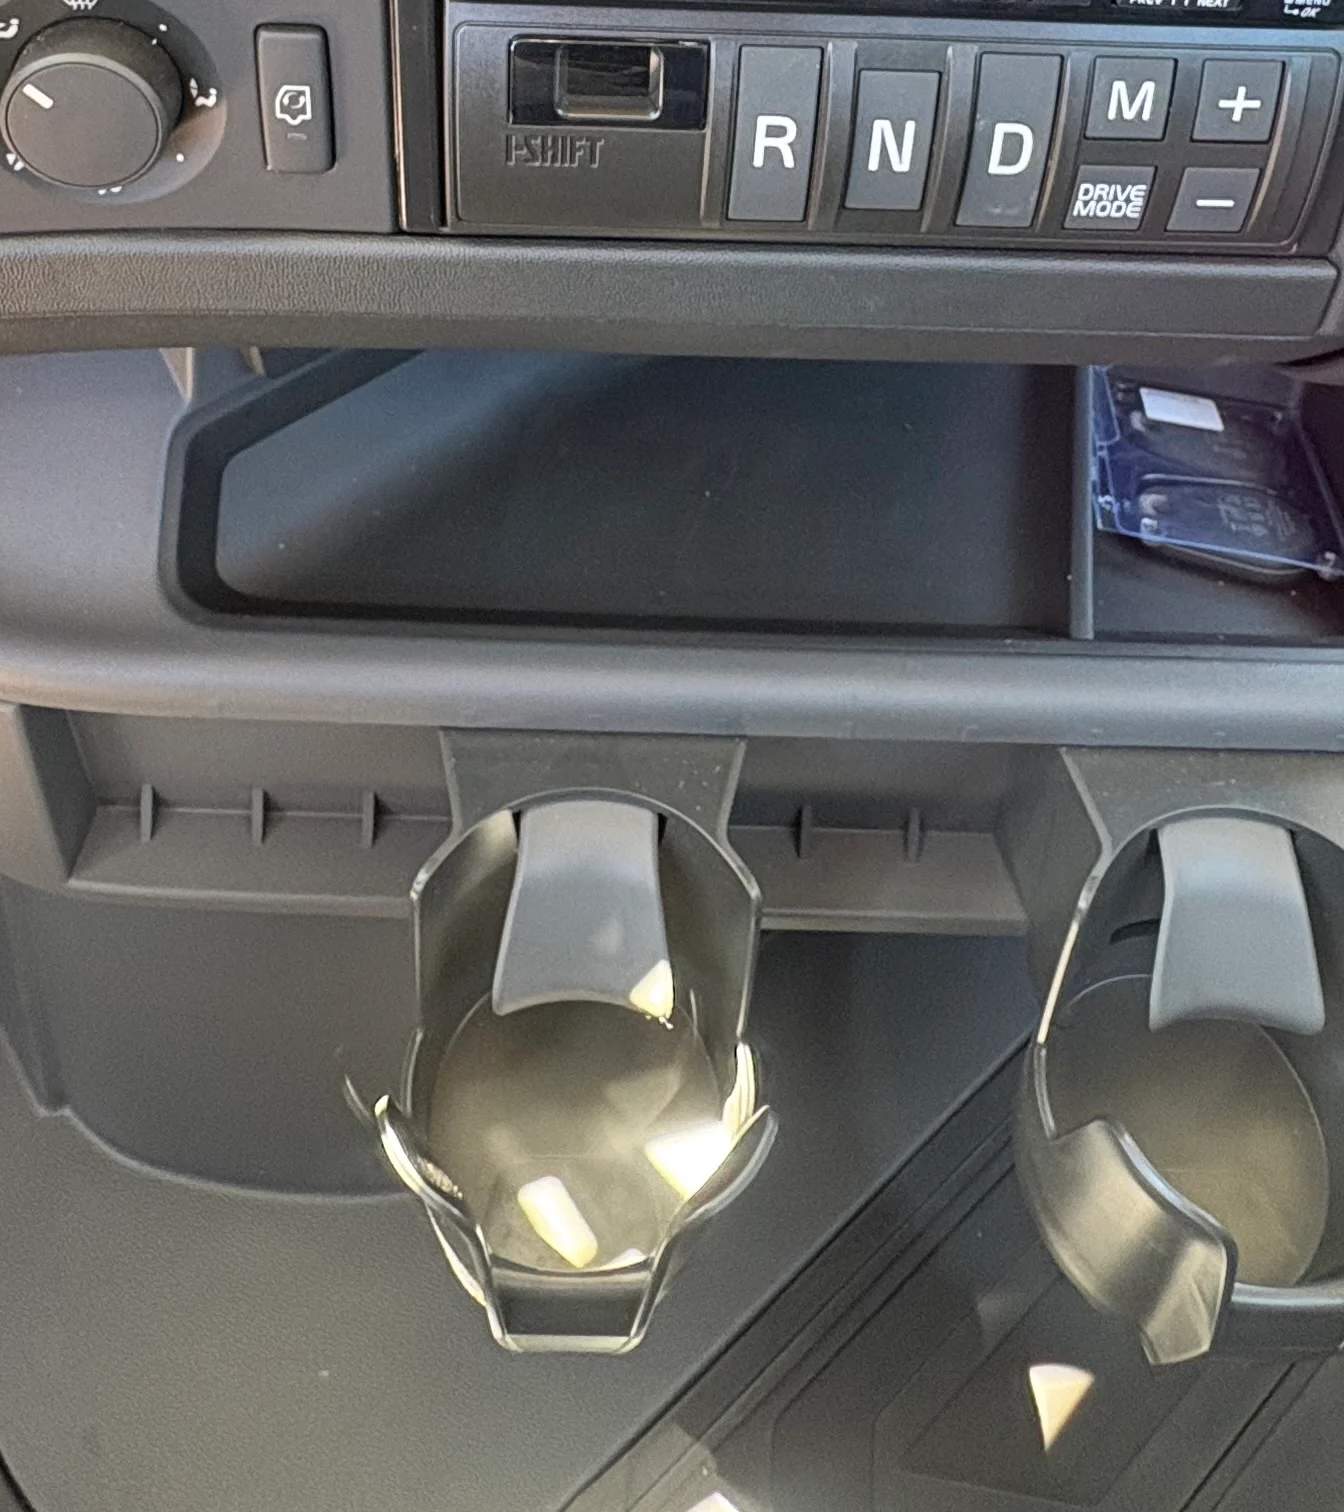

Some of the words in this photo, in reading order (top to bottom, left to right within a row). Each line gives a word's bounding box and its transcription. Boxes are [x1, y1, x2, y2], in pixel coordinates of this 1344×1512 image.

[1300, 6, 1321, 18] OK
[1107, 80, 1156, 121] M
[752, 115, 797, 168] R
[867, 119, 916, 173] N
[987, 122, 1033, 175] D
[1072, 199, 1143, 219] MODE
[1077, 183, 1148, 203] DRIVE
